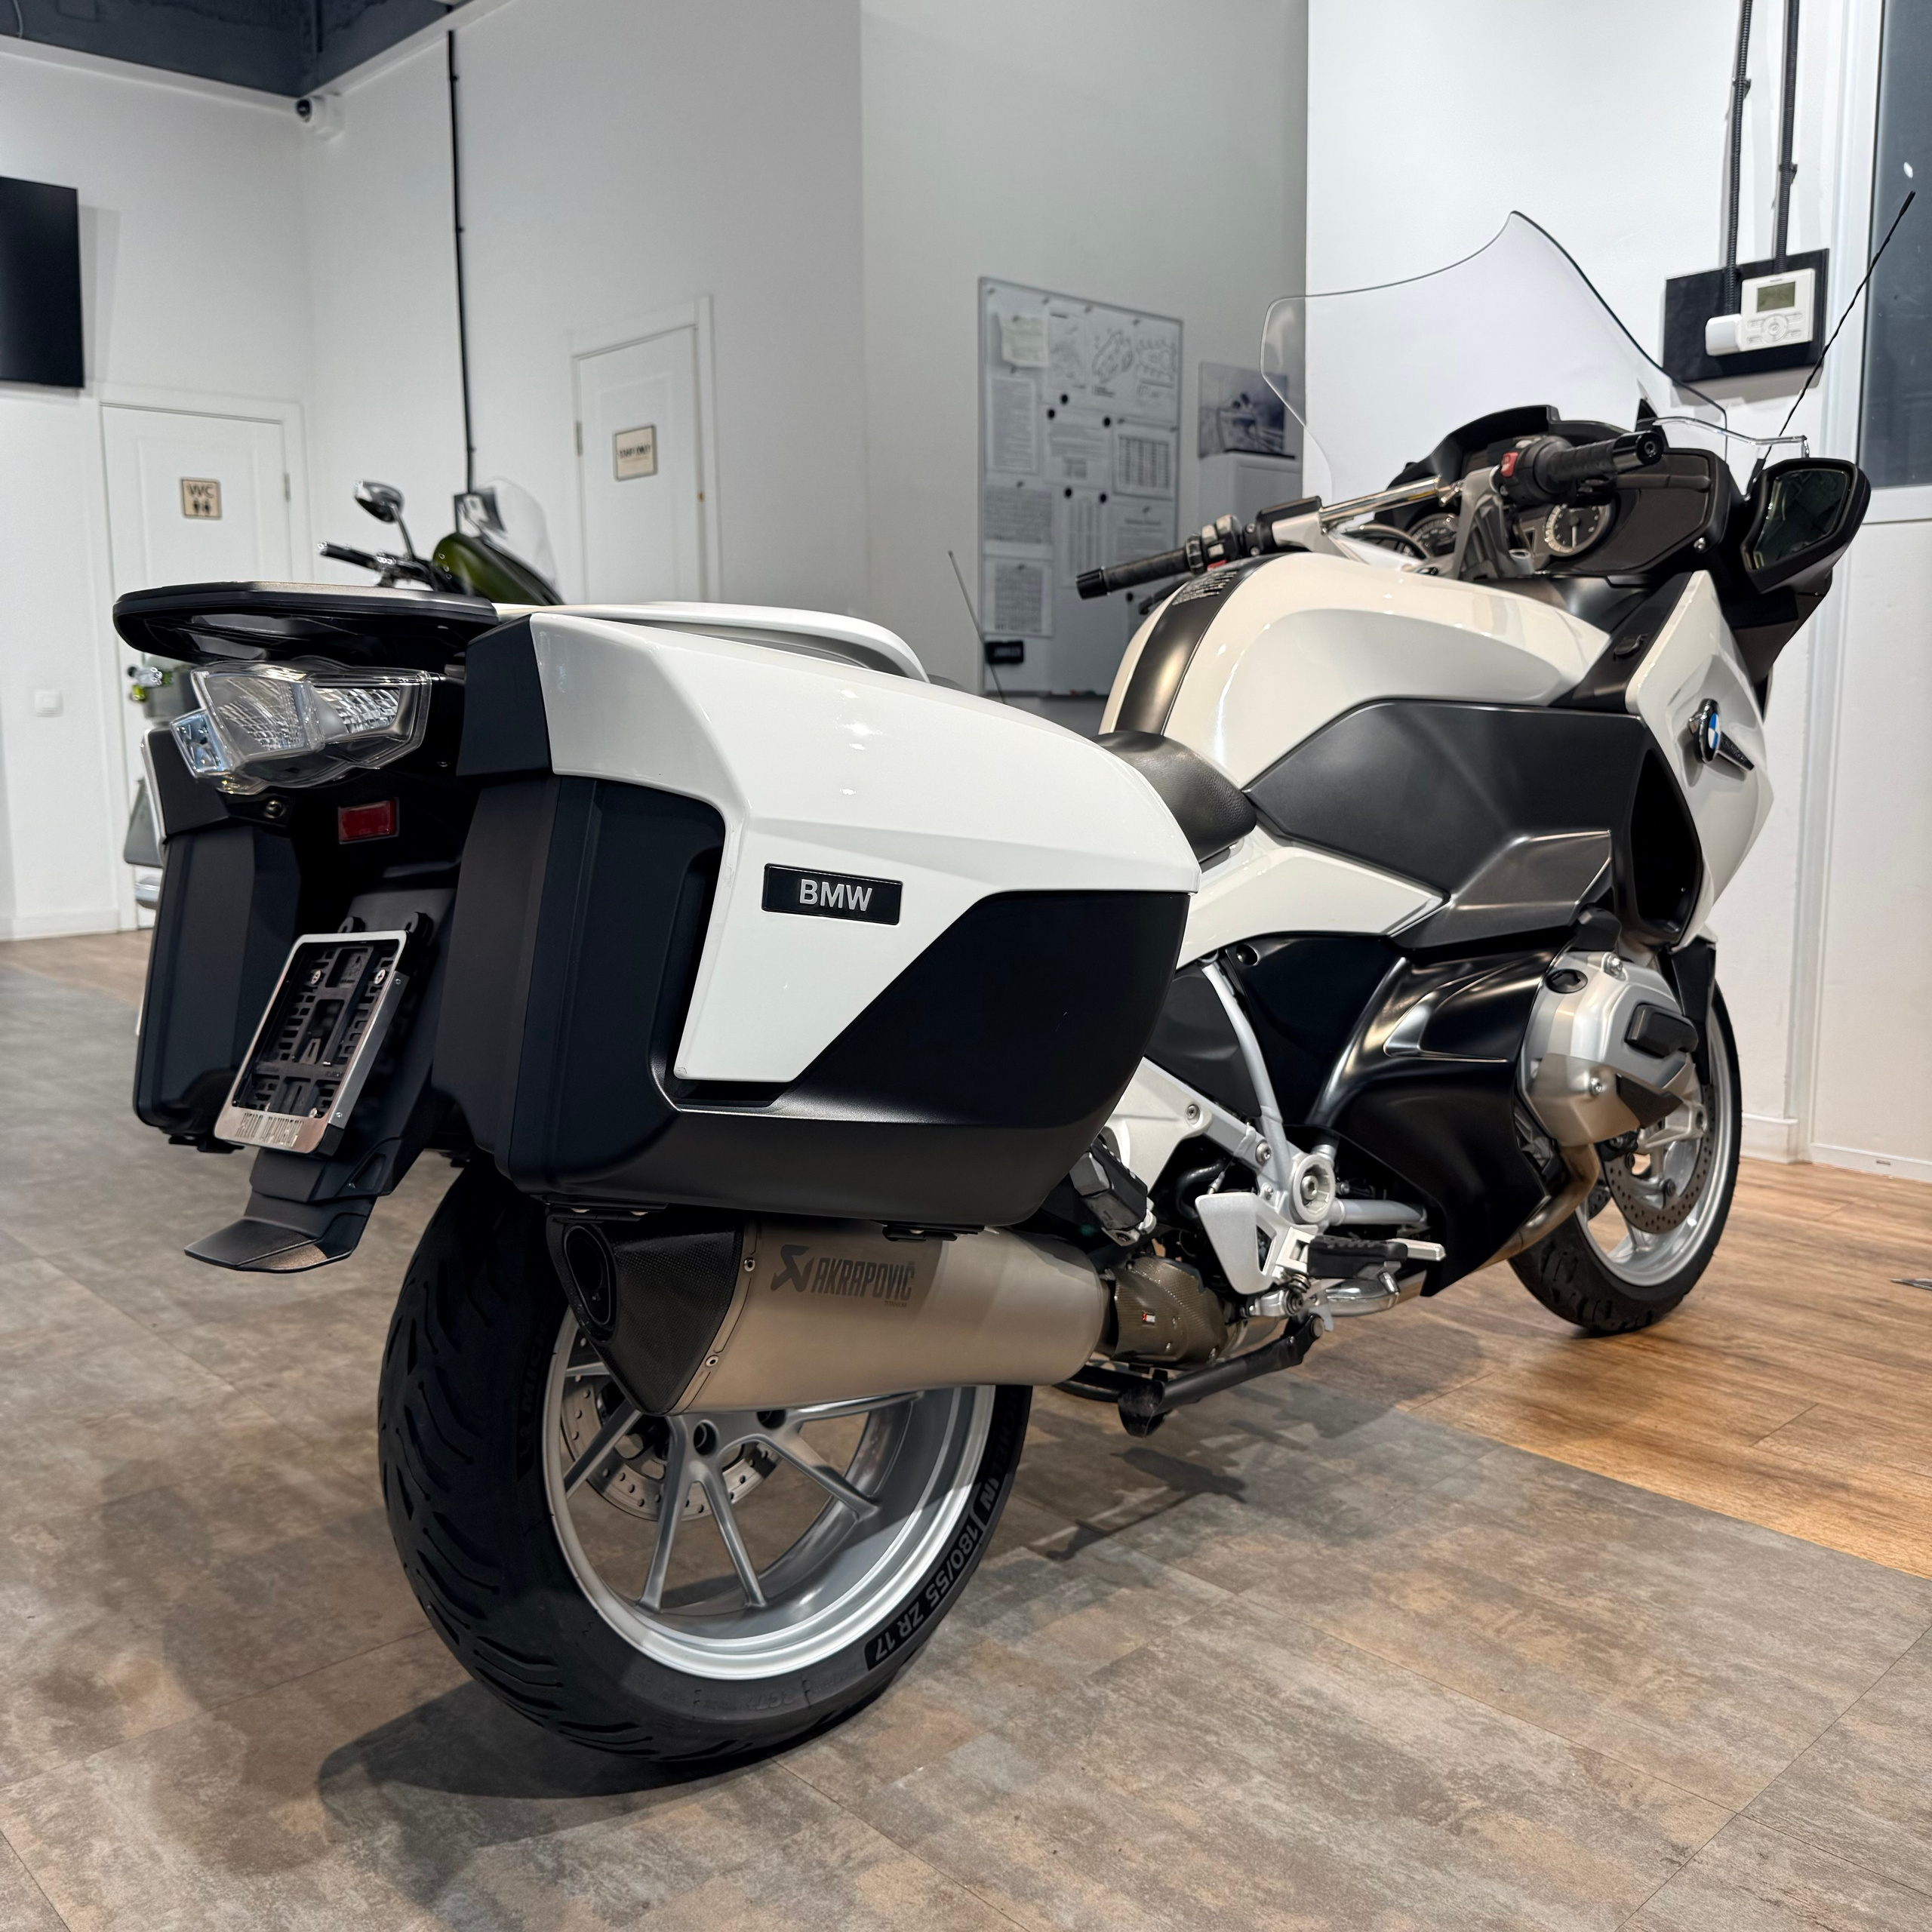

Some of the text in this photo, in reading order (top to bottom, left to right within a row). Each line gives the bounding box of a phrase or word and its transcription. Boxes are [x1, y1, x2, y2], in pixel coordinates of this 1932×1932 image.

[186, 484, 214, 499] WC
[800, 879, 872, 912] BMW
[875, 1524, 979, 1661] 180/55 ZR 17
